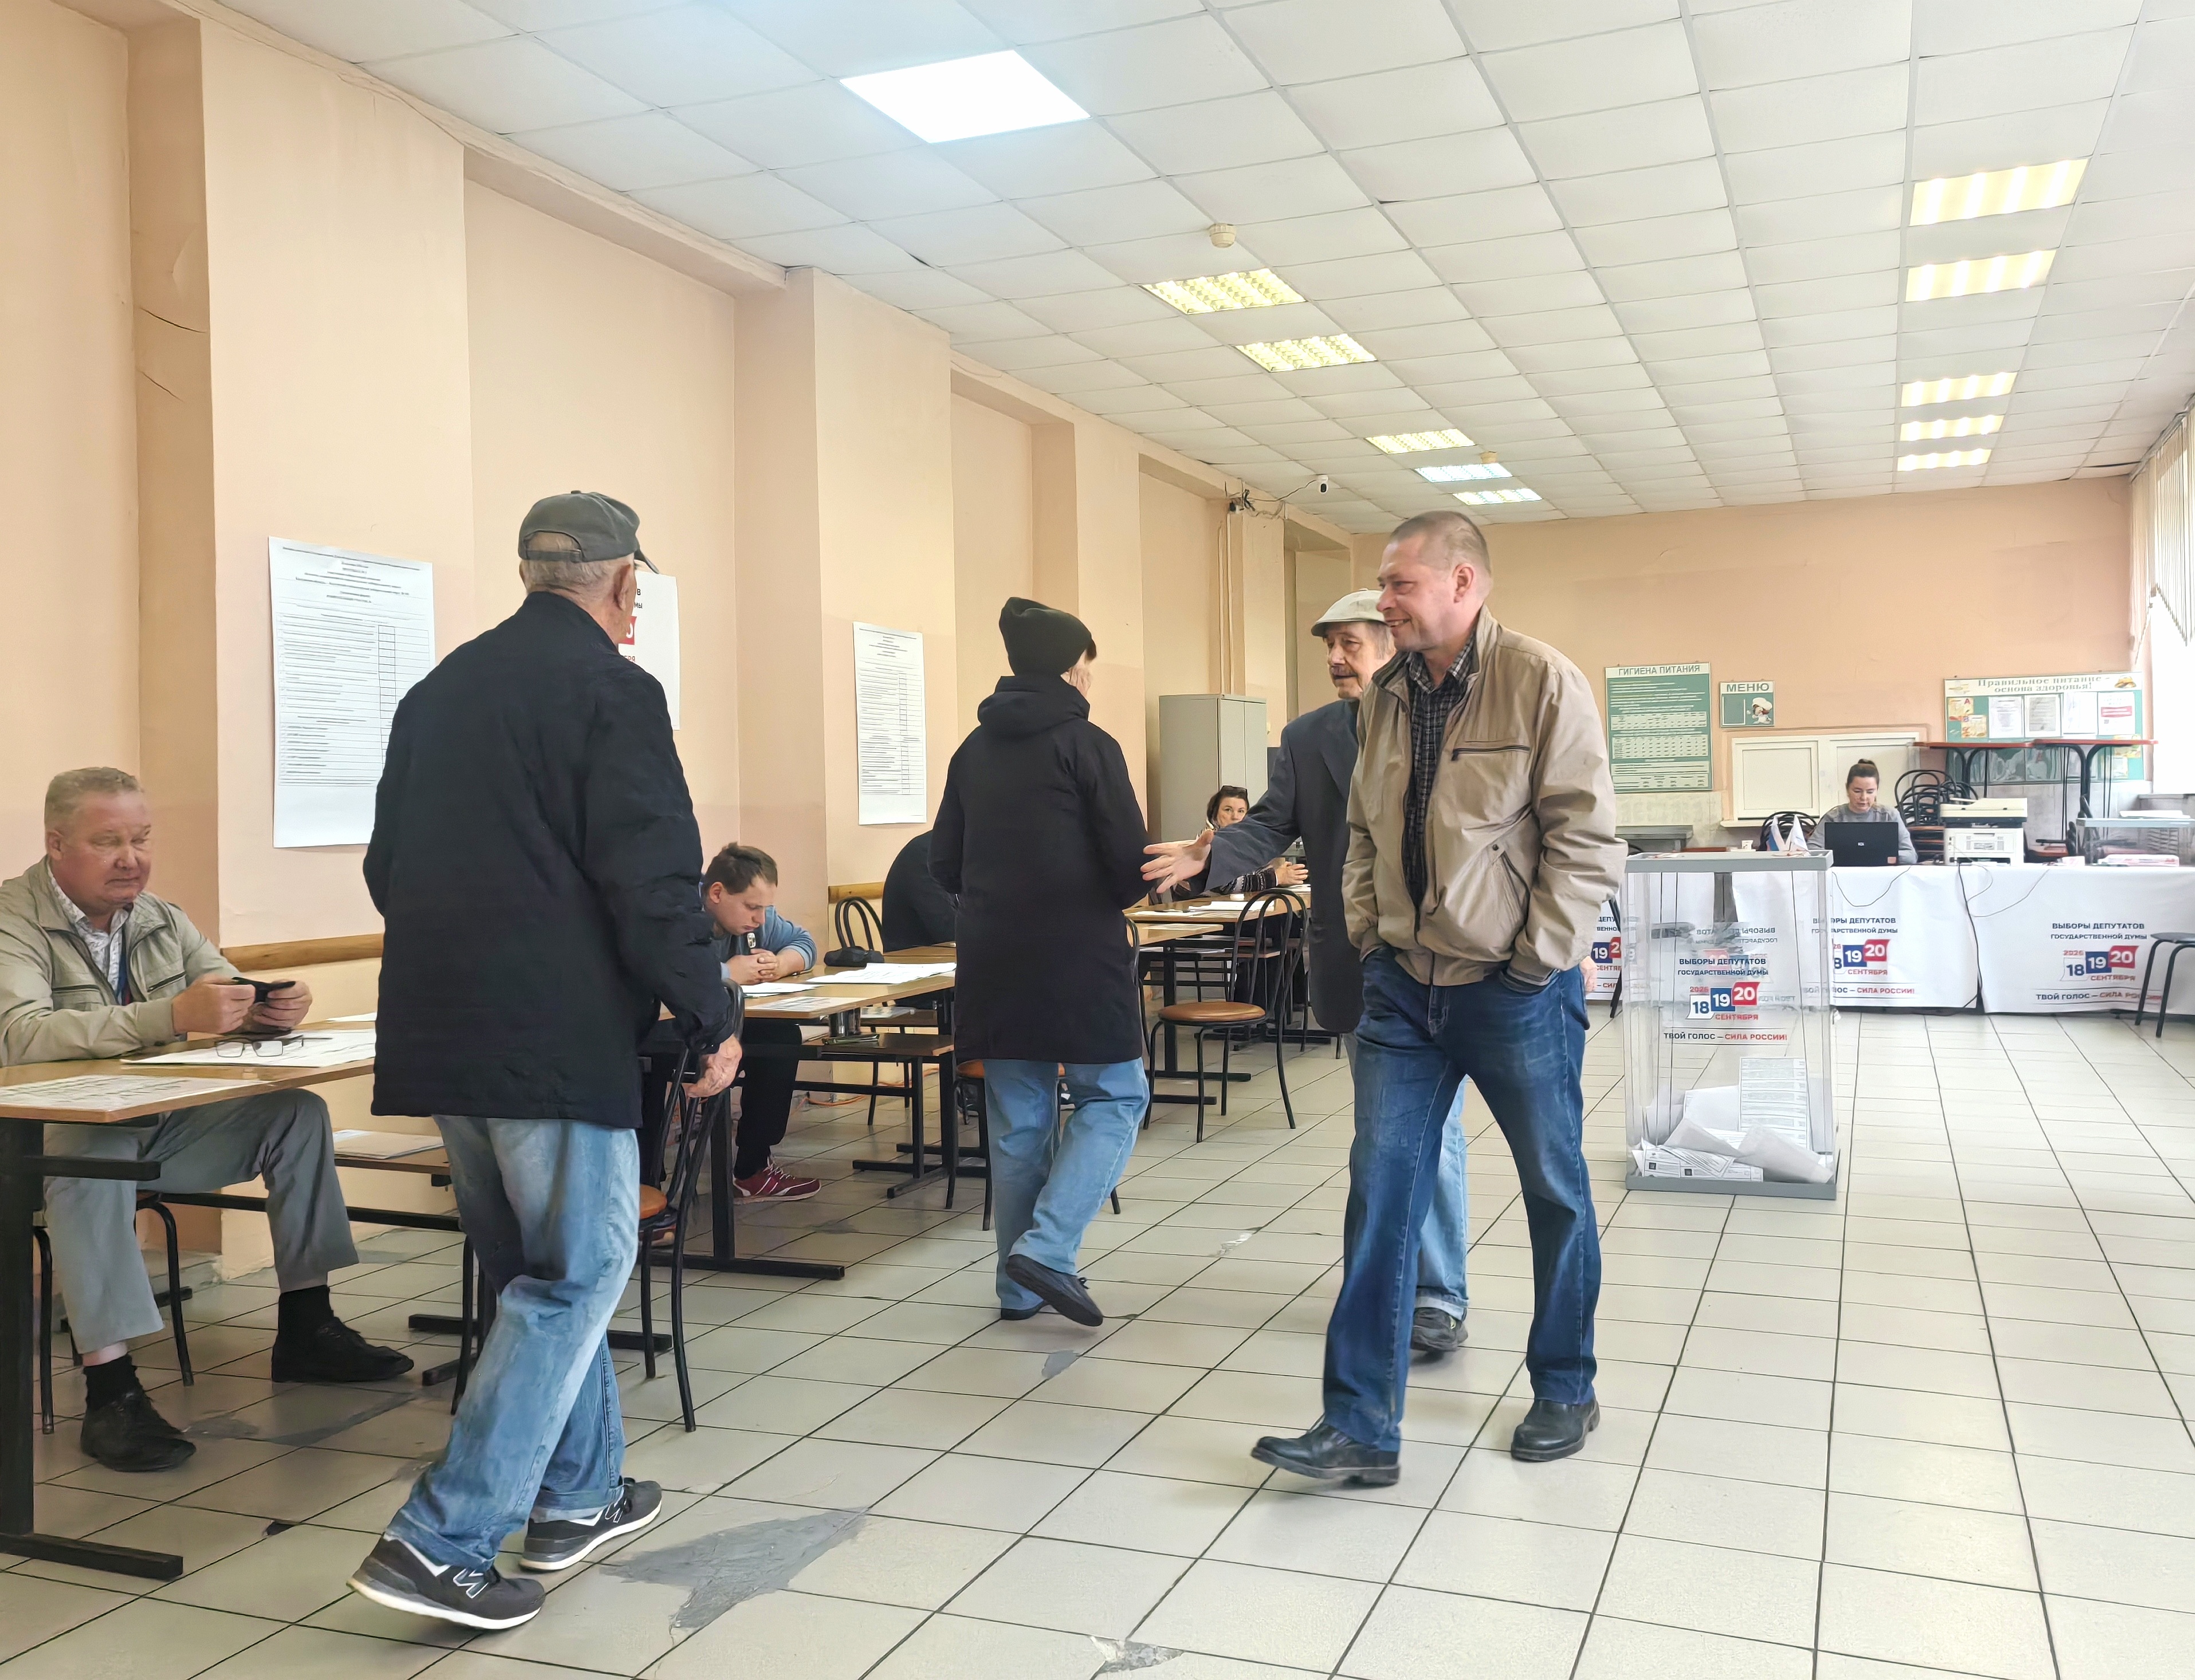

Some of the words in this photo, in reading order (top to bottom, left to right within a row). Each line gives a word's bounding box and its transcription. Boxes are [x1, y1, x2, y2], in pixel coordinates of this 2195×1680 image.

[1659, 665, 1700, 673] ПИТАНИЯ
[1726, 683, 1769, 692] МЕНЮ
[1592, 947, 1608, 959] 19
[1611, 942, 1620, 953] 2
[1845, 950, 1862, 963] 19
[1865, 944, 1885, 957] 20
[2066, 964, 2084, 977] 18
[2088, 957, 2106, 969] 19
[2111, 951, 2133, 963] 20
[1693, 1001, 1709, 1014] 18
[1713, 994, 1730, 1007] 19
[1734, 987, 1755, 1000] 20
